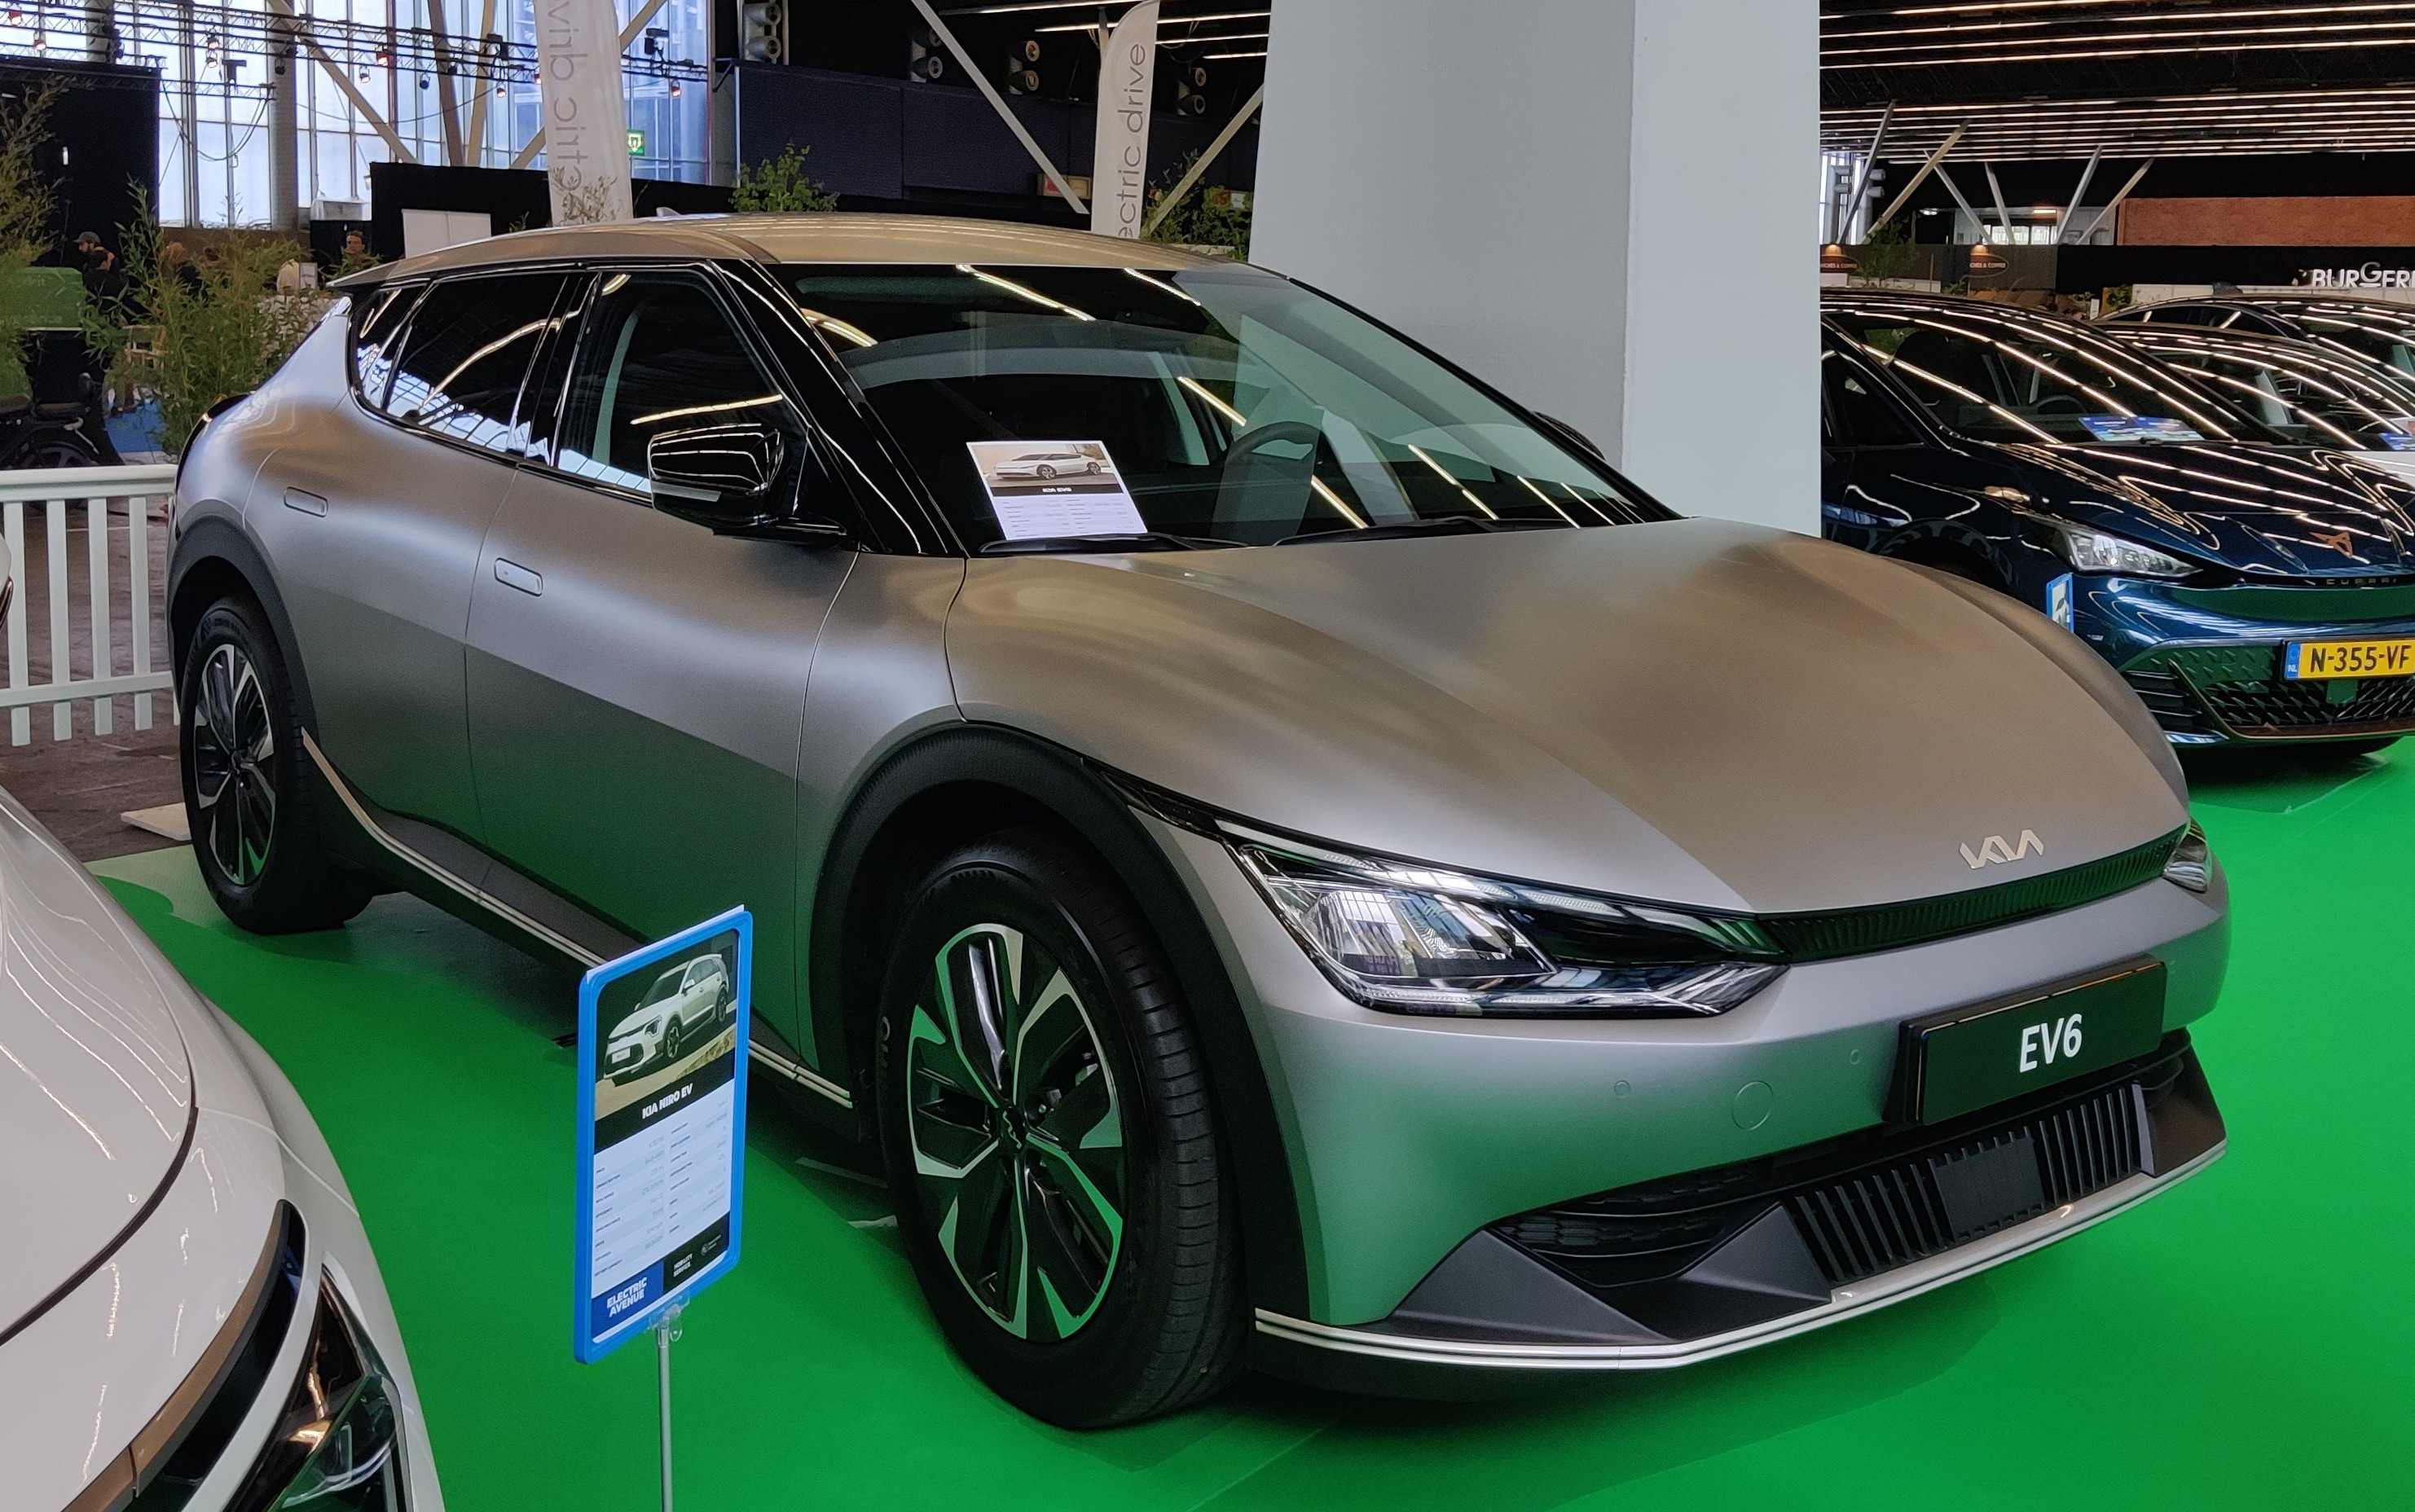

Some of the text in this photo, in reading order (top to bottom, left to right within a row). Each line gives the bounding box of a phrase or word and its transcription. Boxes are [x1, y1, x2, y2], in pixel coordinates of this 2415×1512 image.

[1116, 44, 1146, 238] ectric drive
[2312, 262, 2415, 288] BURGER
[2287, 664, 2298, 673] NL
[2310, 644, 2412, 673] N-355-VF
[2019, 1013, 2083, 1073] EV6
[642, 1083, 693, 1119] KIA NIRO EV
[606, 1277, 648, 1309] ELECTRIC
[609, 1289, 644, 1318] AVENUE
